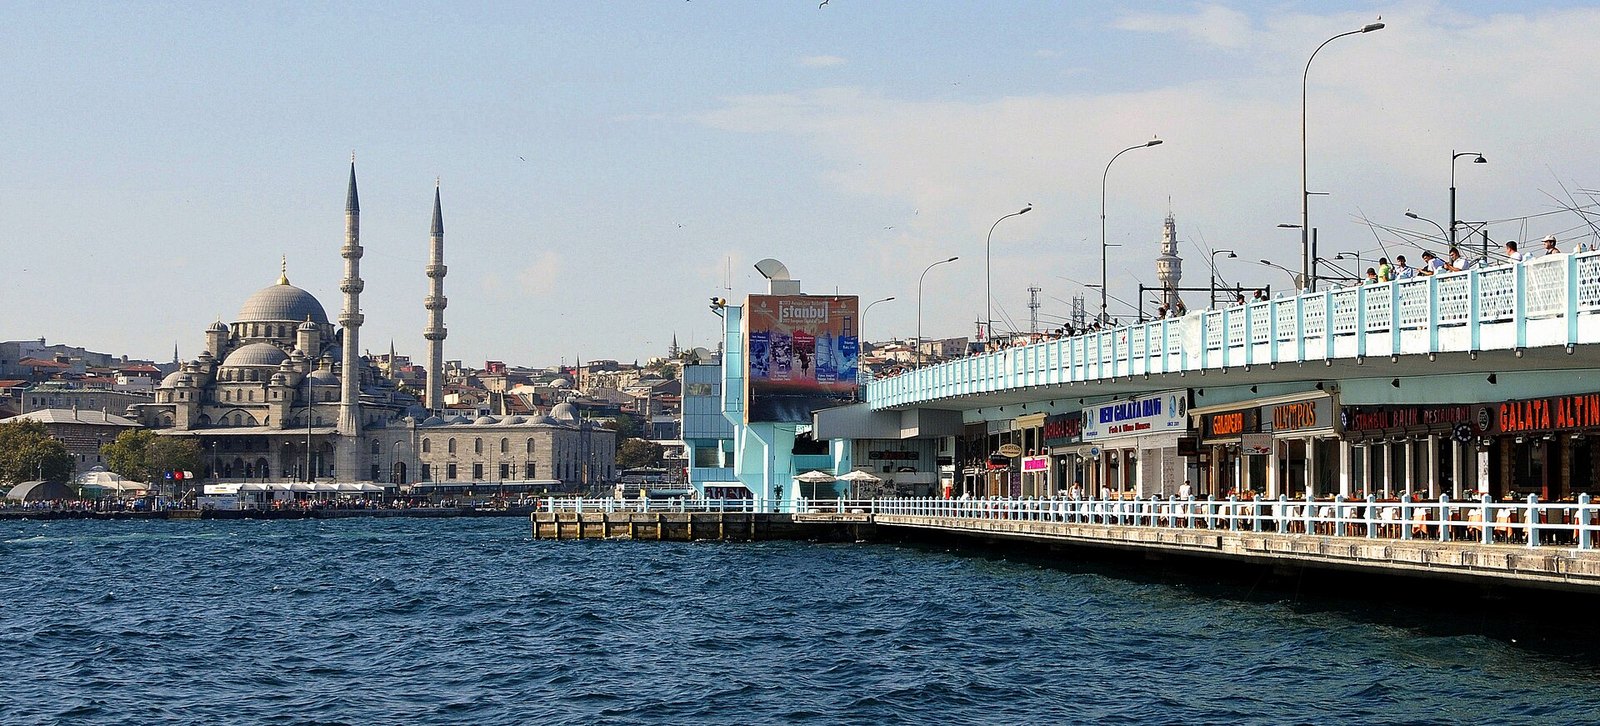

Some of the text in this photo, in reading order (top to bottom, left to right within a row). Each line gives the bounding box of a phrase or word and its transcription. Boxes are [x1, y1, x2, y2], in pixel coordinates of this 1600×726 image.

[1115, 401, 1141, 421] GALATA
[1274, 401, 1316, 429] OLYMPOS
[1500, 394, 1600, 432] GALATA ALTIN
